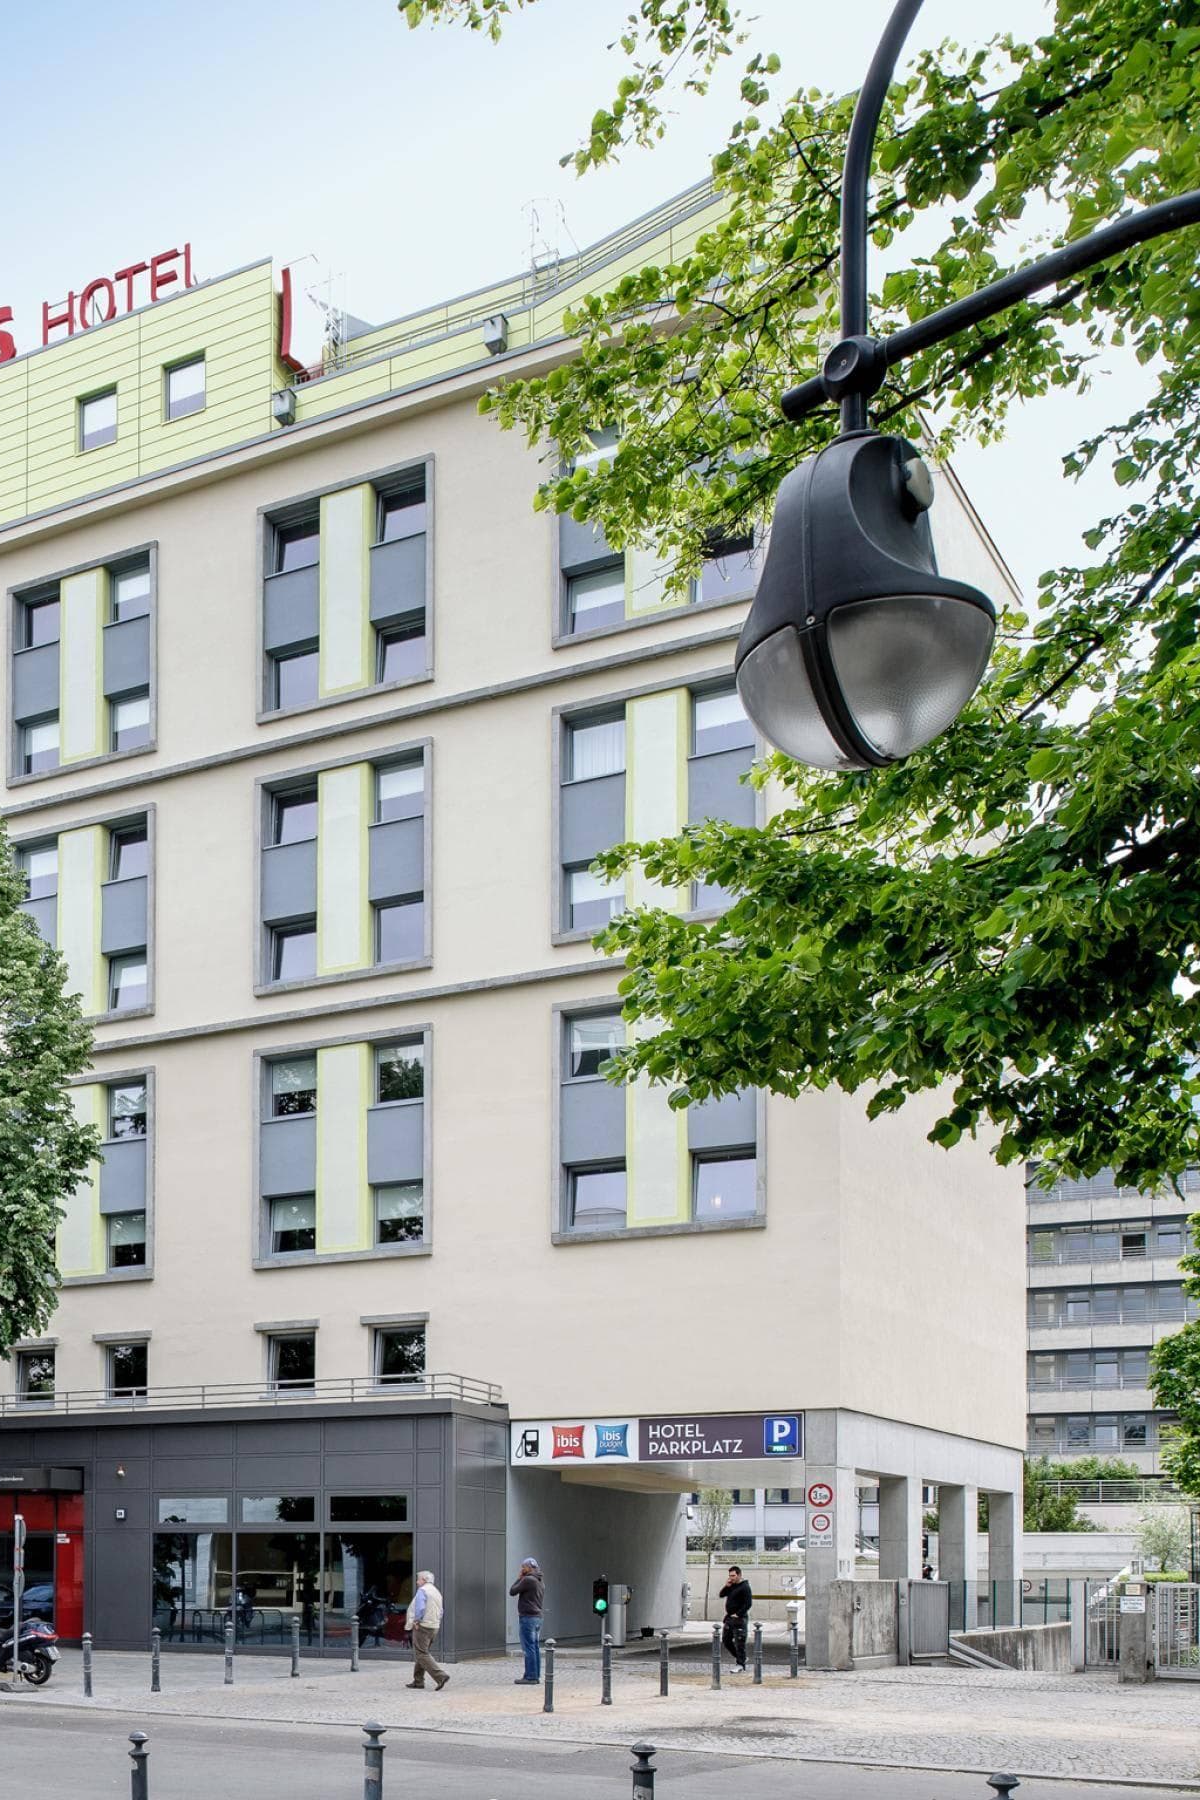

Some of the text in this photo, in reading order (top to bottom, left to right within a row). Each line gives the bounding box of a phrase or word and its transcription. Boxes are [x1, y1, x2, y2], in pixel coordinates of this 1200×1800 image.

[42, 242, 198, 346] HOTEL
[603, 1430, 621, 1441] ibis
[648, 1424, 705, 1439] HOTEL
[772, 1420, 791, 1443] P
[557, 1434, 580, 1448] ibis
[600, 1440, 623, 1448] budget
[648, 1439, 743, 1455] PARKPLATZ
